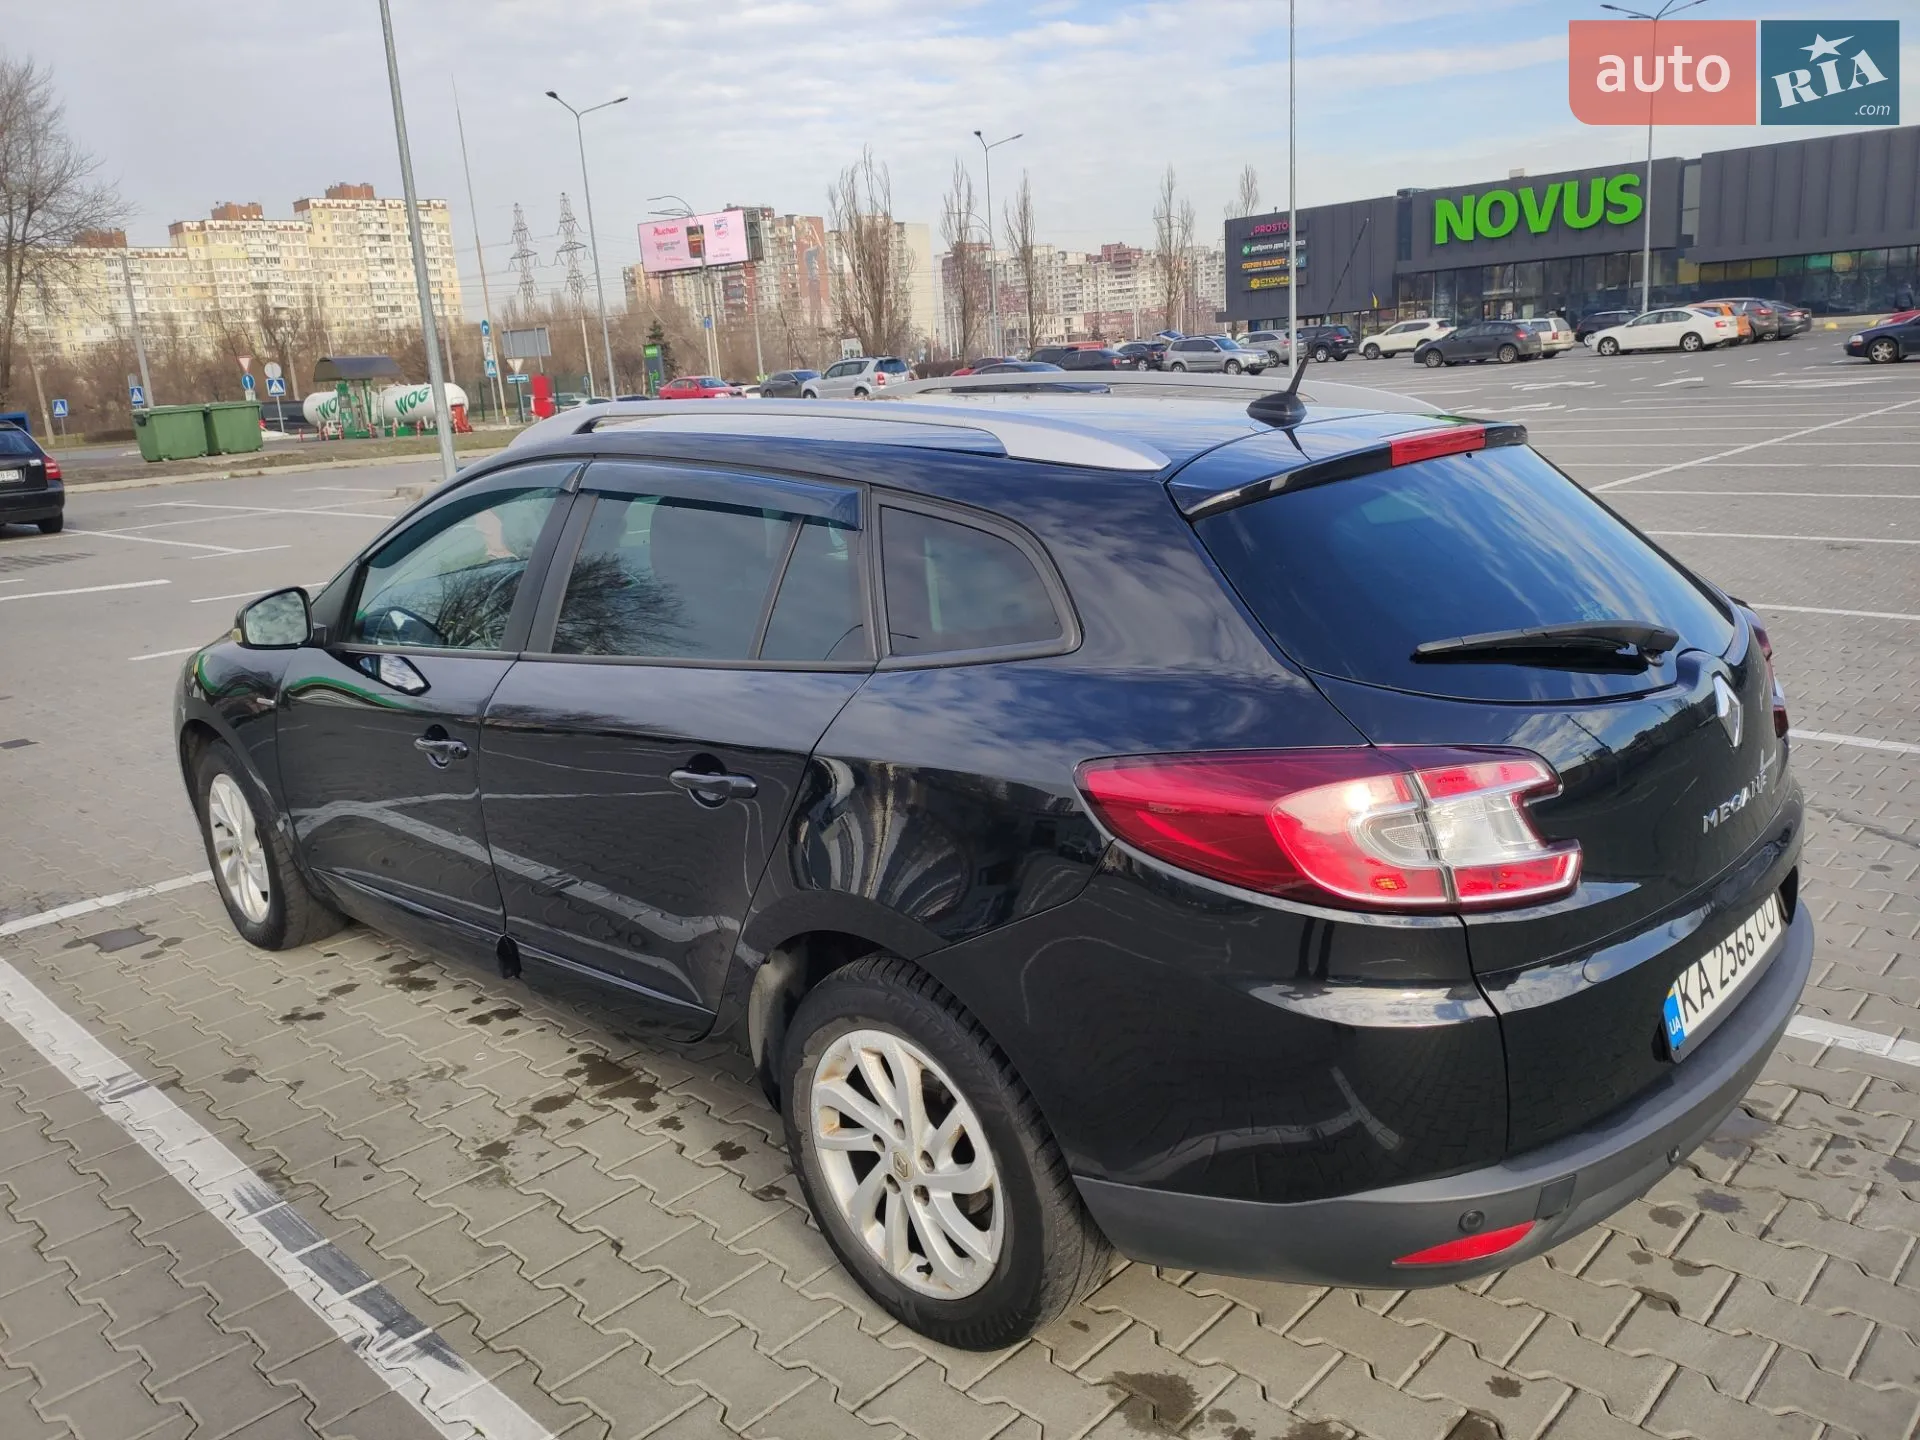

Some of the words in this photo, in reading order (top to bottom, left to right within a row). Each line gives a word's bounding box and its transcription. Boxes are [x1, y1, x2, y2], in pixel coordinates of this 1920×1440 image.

[1435, 174, 1643, 244] NOVUS
[653, 226, 679, 237] Auchan
[1253, 222, 1292, 233] PROSTO
[317, 397, 338, 420] WO
[395, 387, 430, 415] WOG
[1676, 959, 1715, 1023] KA
[1713, 921, 1755, 990] 2566
[1668, 1015, 1682, 1035] UA
